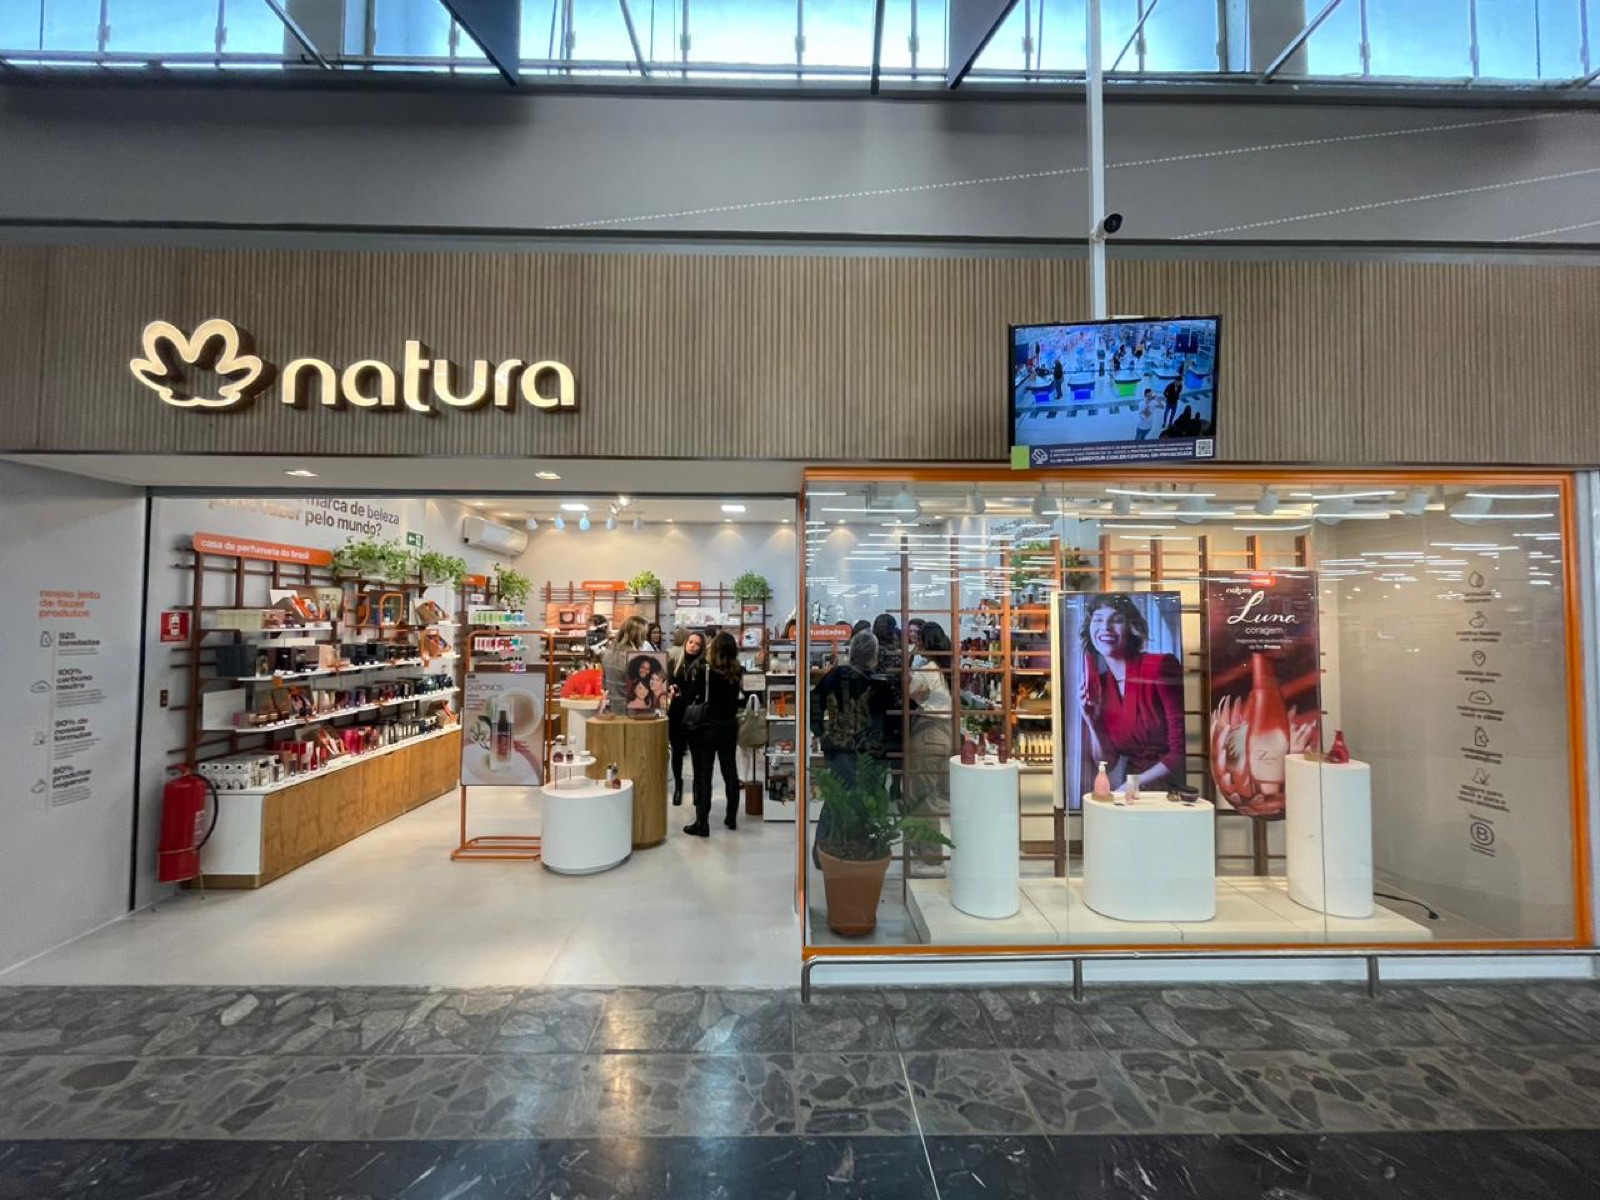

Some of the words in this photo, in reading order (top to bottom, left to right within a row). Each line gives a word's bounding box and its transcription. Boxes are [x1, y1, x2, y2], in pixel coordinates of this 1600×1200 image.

[282, 340, 575, 411] natura
[305, 510, 335, 526] pelo
[337, 517, 382, 536] mundo?
[350, 501, 365, 516] de
[367, 505, 400, 525] beleza
[200, 539, 223, 550] casa
[1226, 587, 1252, 595] natura
[1227, 590, 1299, 625] Luna
[1245, 627, 1284, 635] coragem
